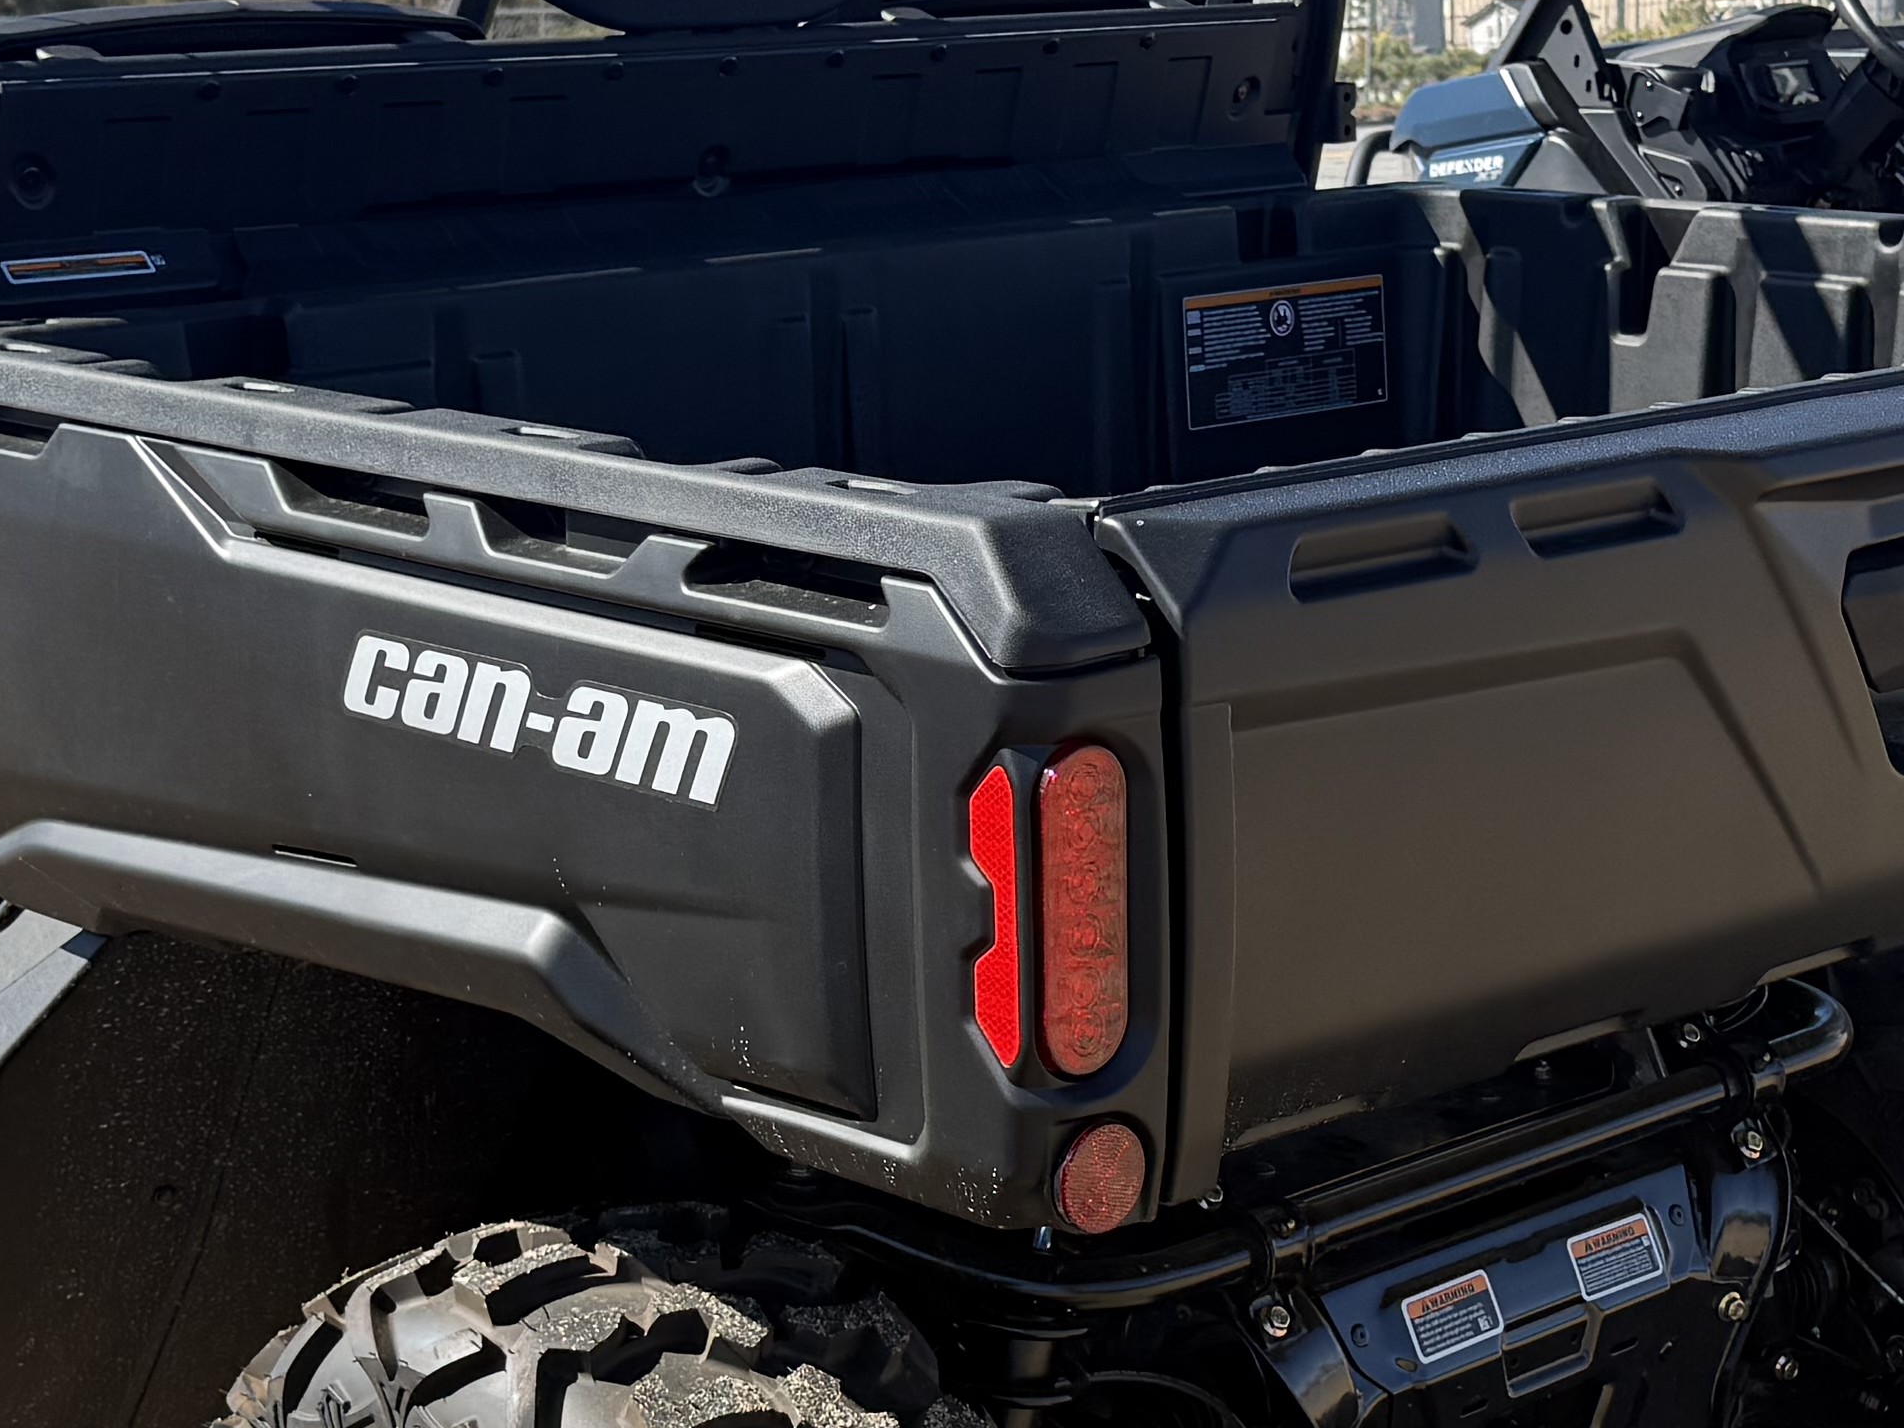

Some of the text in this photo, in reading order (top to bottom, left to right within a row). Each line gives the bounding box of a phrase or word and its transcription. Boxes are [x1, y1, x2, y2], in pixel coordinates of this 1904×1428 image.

[1429, 155, 1504, 178] DEFENDER
[344, 635, 735, 805] can-am
[1430, 1283, 1475, 1309] WARNING
